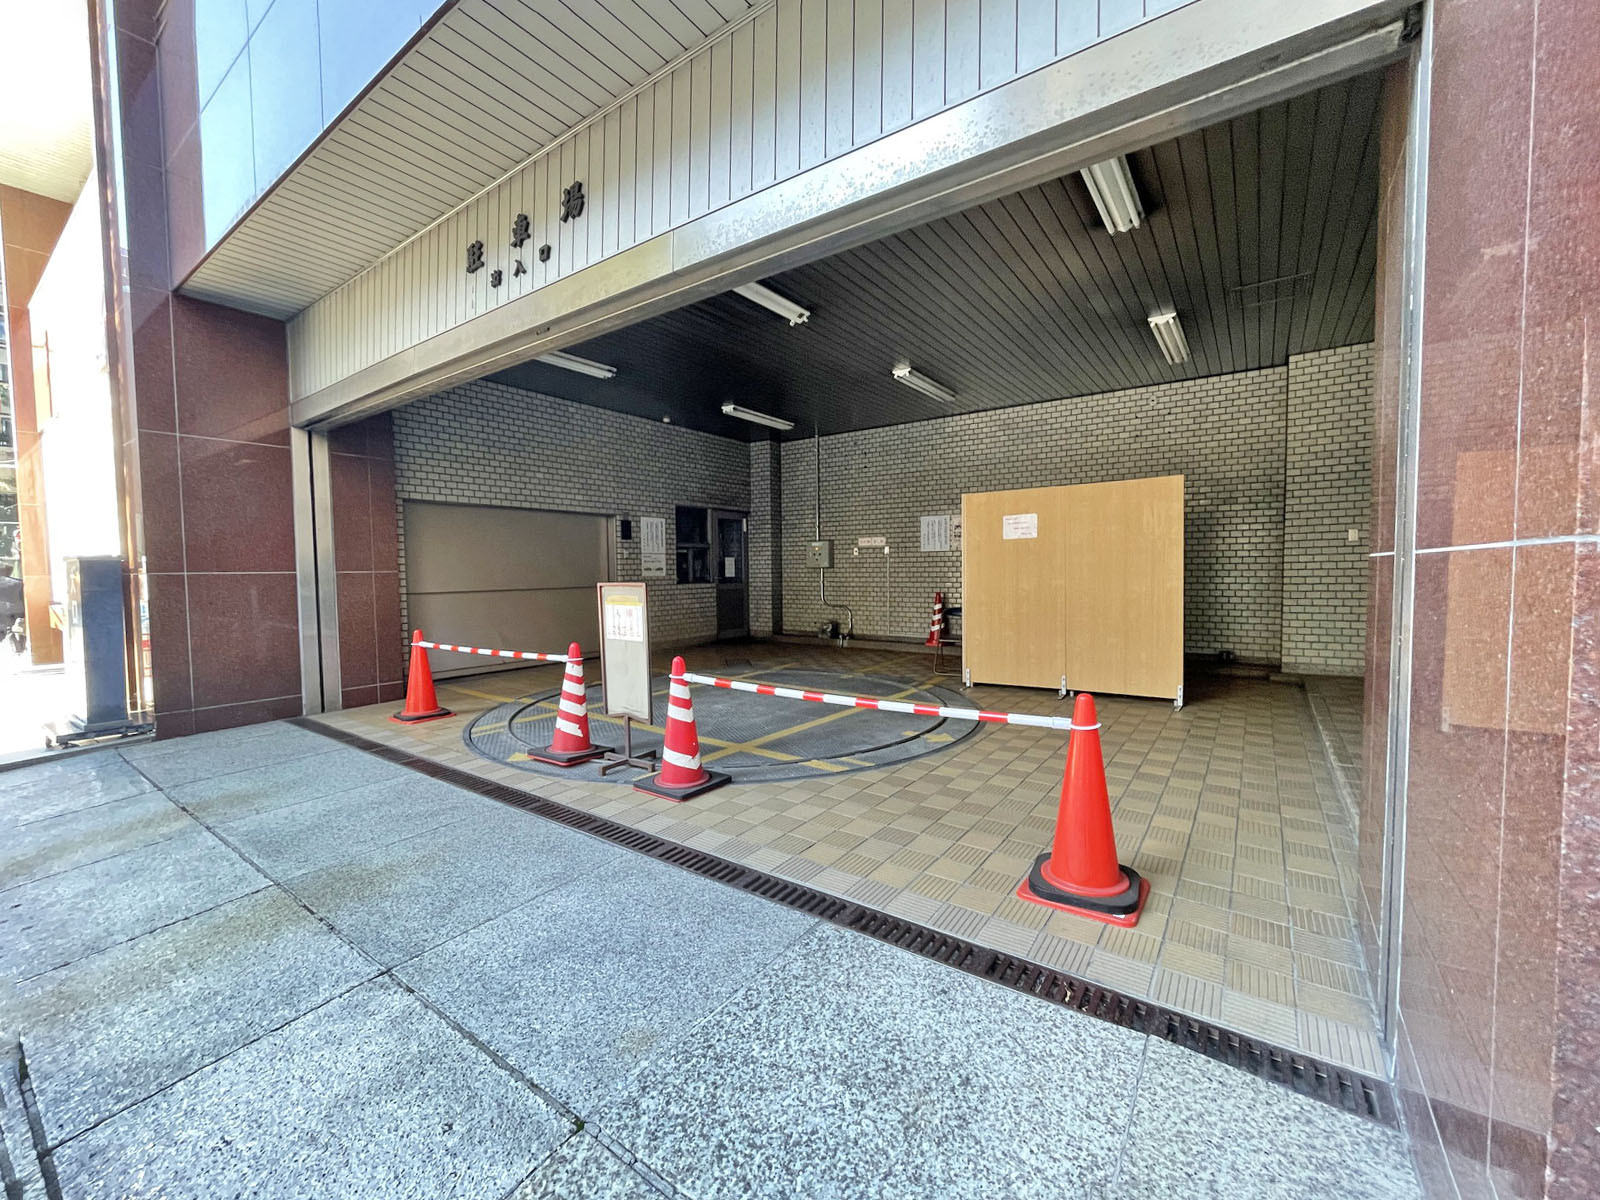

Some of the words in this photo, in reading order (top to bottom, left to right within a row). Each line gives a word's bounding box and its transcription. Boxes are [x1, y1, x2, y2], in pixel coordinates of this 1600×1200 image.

[467, 181, 585, 274] 駐車場
[490, 244, 551, 288] 出入口
